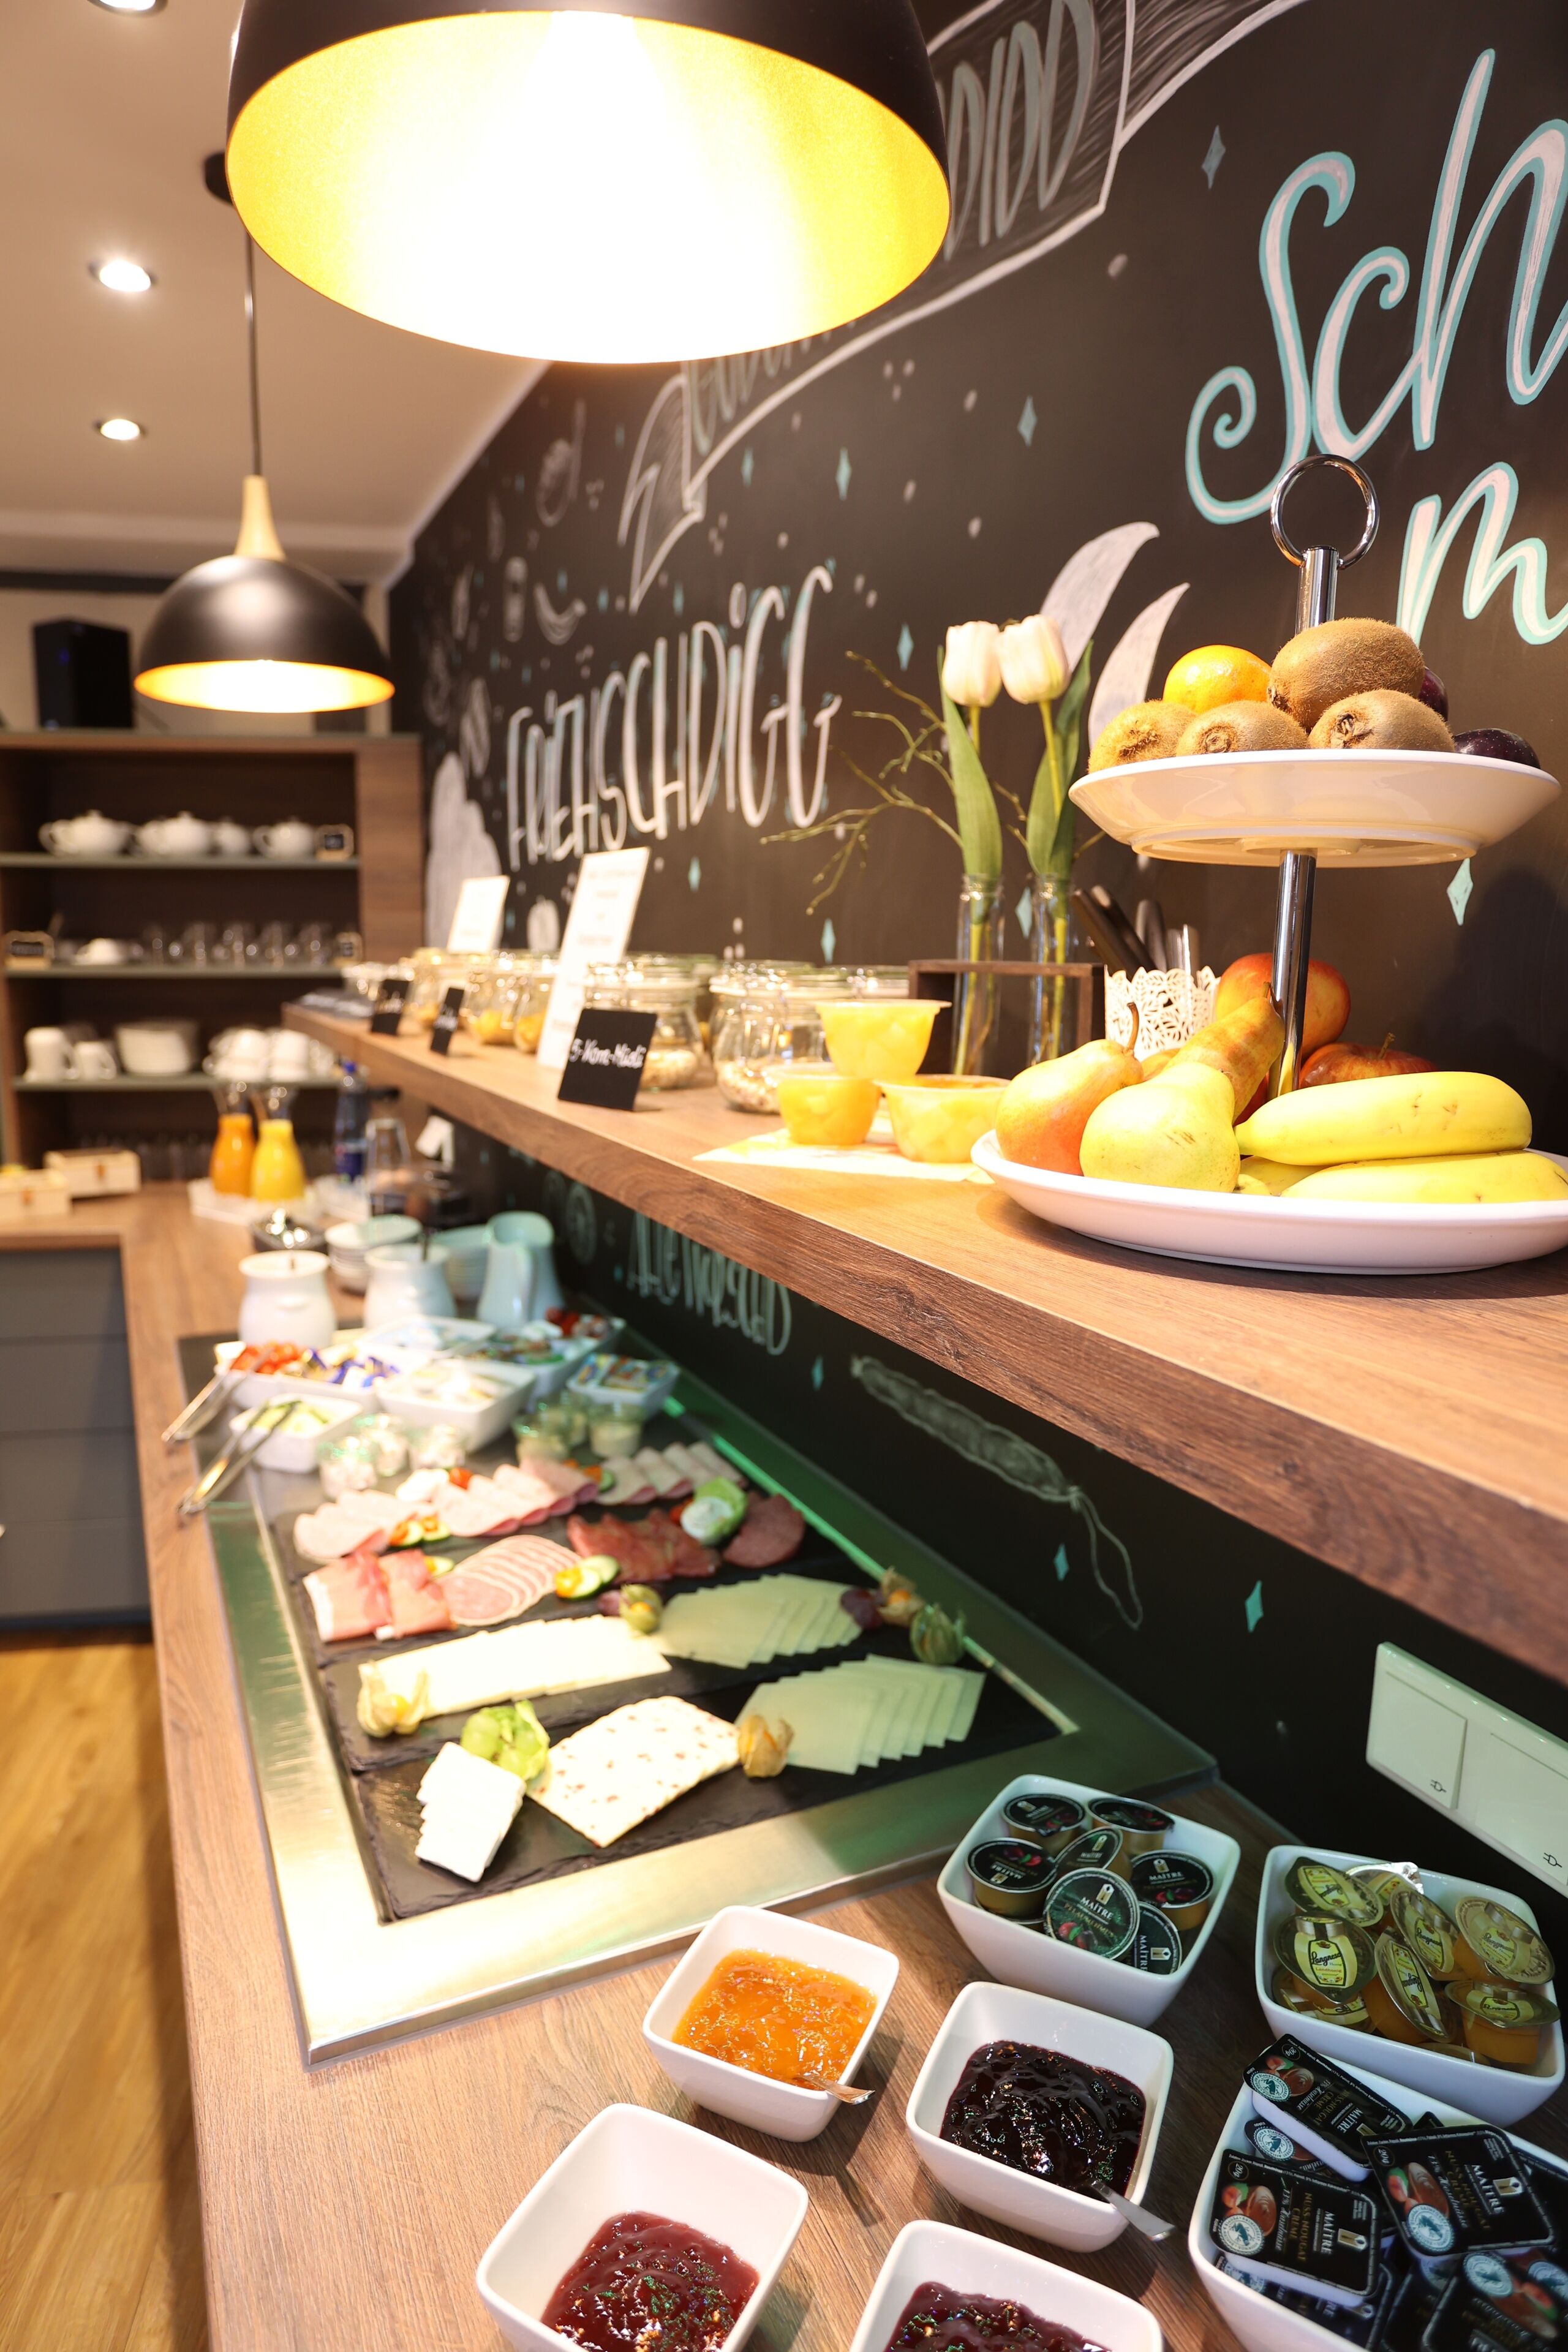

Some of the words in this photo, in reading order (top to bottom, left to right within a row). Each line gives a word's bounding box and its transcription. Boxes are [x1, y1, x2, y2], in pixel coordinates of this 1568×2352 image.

[1080, 1896, 1114, 1921] MAÎTRE
[1310, 1950, 1342, 1967] Langnese
[1336, 2107, 1363, 2133] MAÎTRE
[1321, 2211, 1335, 2255] MAÎTRE
